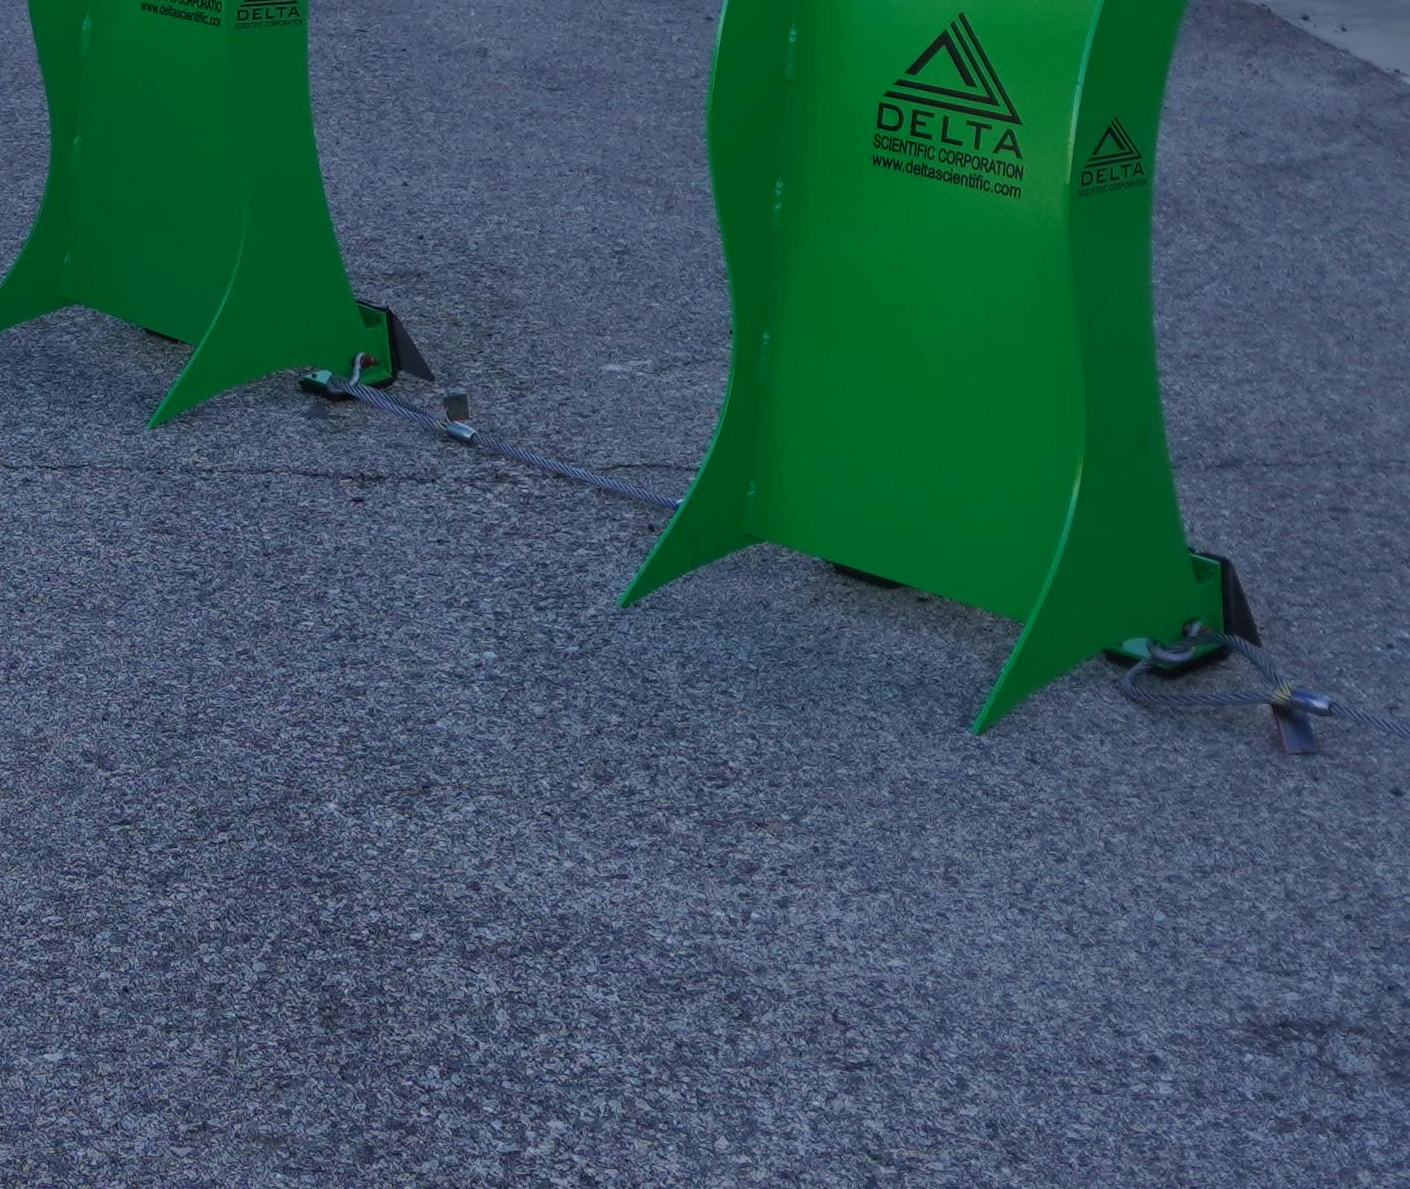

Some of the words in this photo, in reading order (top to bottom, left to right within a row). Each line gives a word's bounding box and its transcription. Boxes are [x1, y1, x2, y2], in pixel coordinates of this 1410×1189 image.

[237, 6, 300, 21] DELTA
[876, 101, 1023, 159] DELTA
[871, 153, 1022, 200] www.deltascientific.com
[873, 133, 936, 161] SCIENTIFIC
[938, 148, 1025, 181] CORPORATION
[1081, 162, 1145, 187] DELTA
